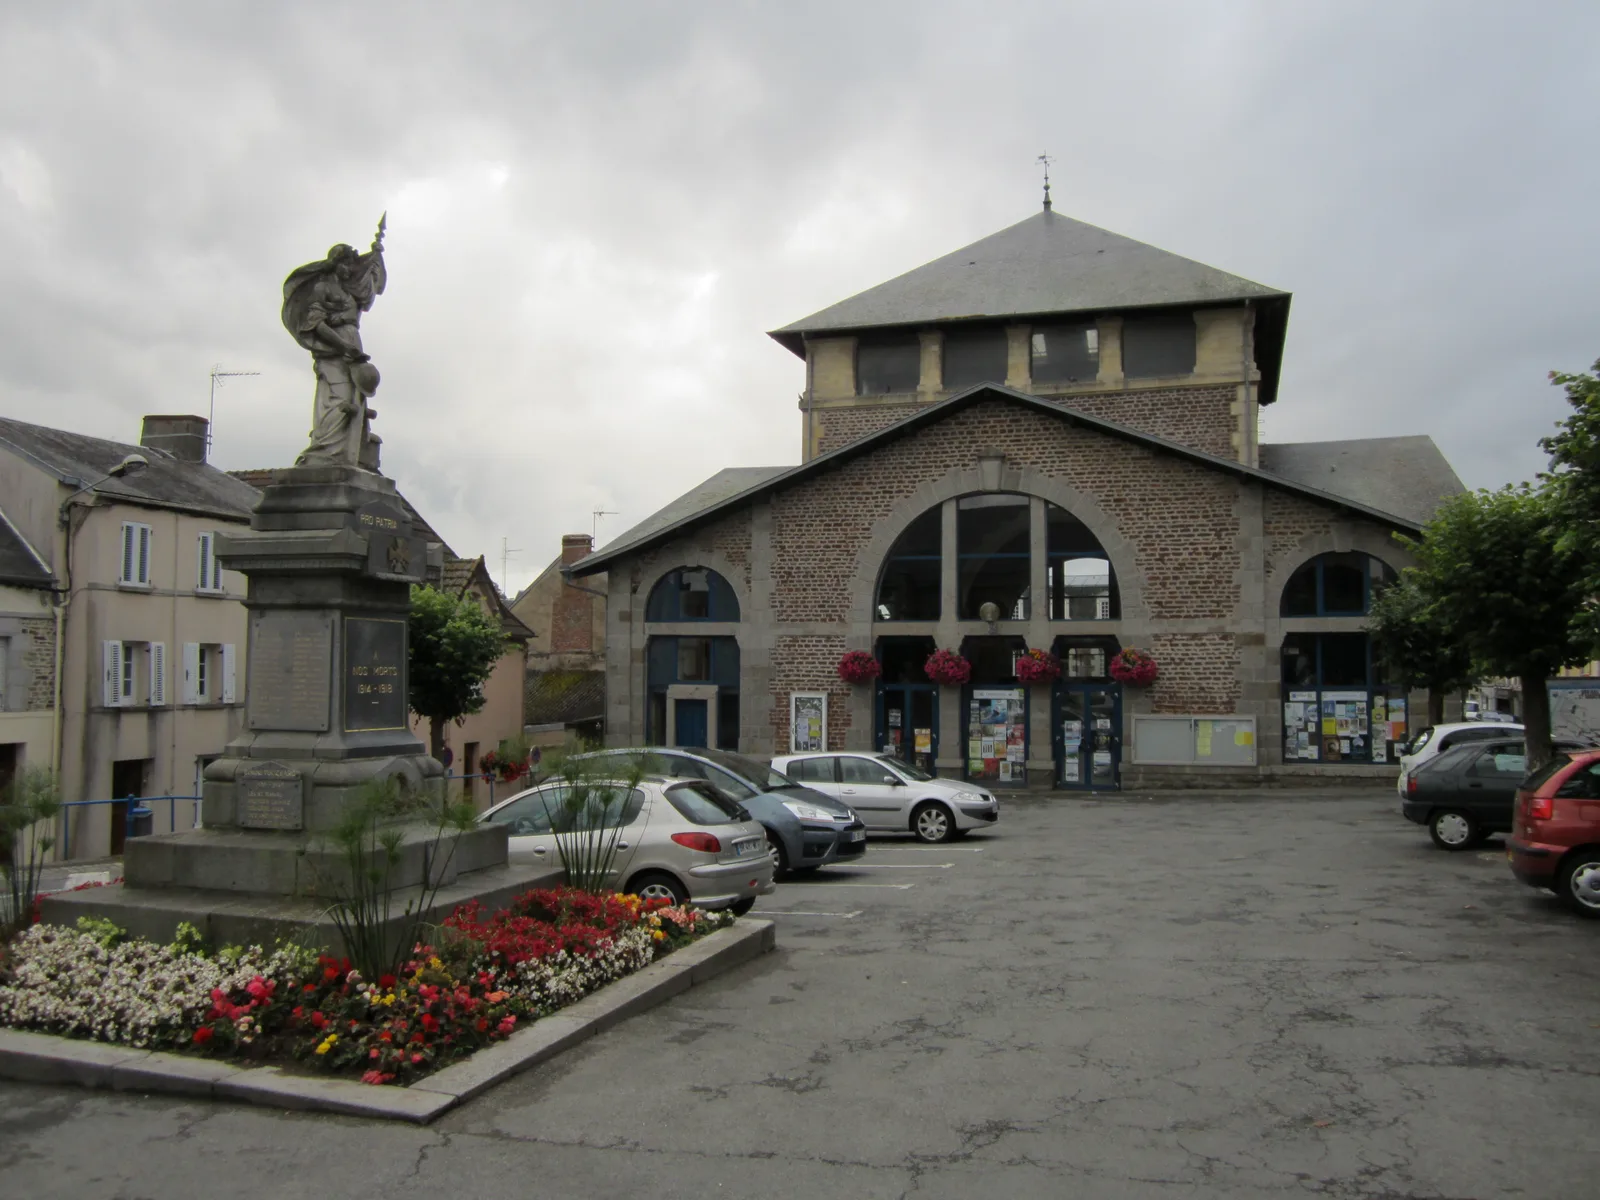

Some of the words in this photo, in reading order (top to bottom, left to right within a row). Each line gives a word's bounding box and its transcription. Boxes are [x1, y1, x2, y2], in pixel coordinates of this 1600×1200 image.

[360, 513, 374, 526] PRO
[375, 516, 398, 529] PATRIA
[352, 666, 368, 676] NOS
[373, 666, 398, 676] MORTS
